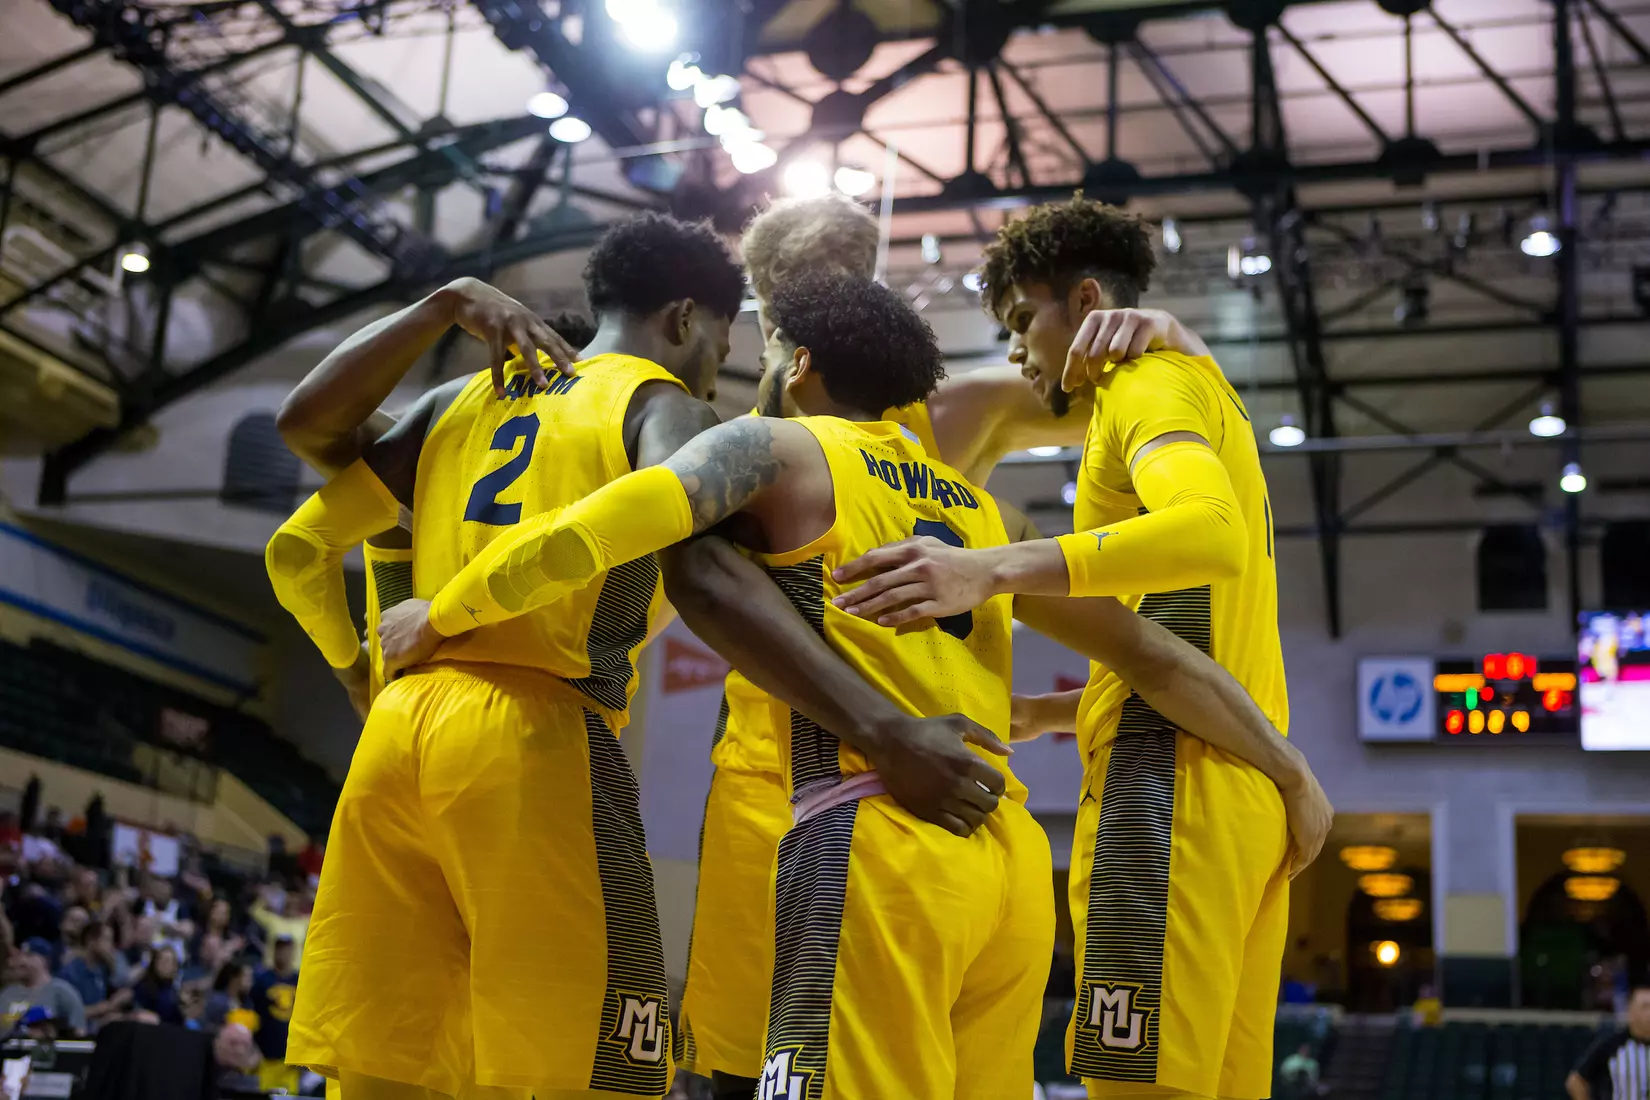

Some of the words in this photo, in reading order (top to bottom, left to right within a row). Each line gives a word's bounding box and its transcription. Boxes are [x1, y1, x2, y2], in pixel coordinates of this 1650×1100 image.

[463, 412, 540, 526] 2
[858, 447, 980, 510] HOWARD
[617, 996, 664, 1063] MU
[1088, 986, 1144, 1050] MU
